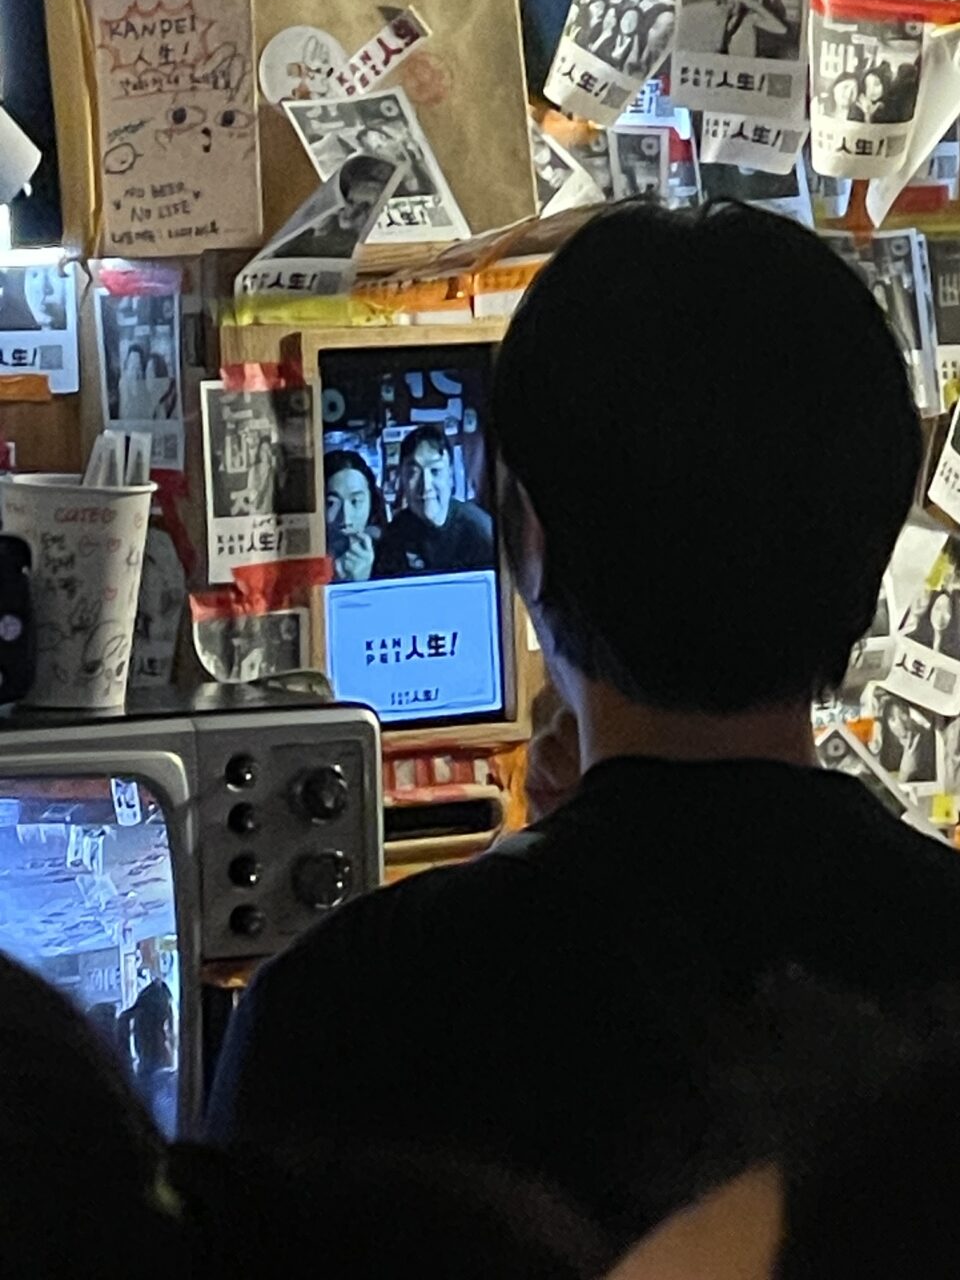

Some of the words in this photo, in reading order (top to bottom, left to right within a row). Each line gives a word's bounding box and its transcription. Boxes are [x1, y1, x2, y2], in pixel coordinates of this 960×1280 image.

[562, 63, 609, 98] 人生!
[716, 70, 766, 92] 人生!
[731, 120, 782, 148] 人生!
[836, 136, 885, 157] 人生!
[268, 272, 319, 292] 人生!
[247, 531, 283, 552] 人生!
[365, 637, 402, 651] KAN
[405, 631, 459, 660] 人生!
[366, 651, 401, 666] PEI
[894, 652, 936, 681] 人生!
